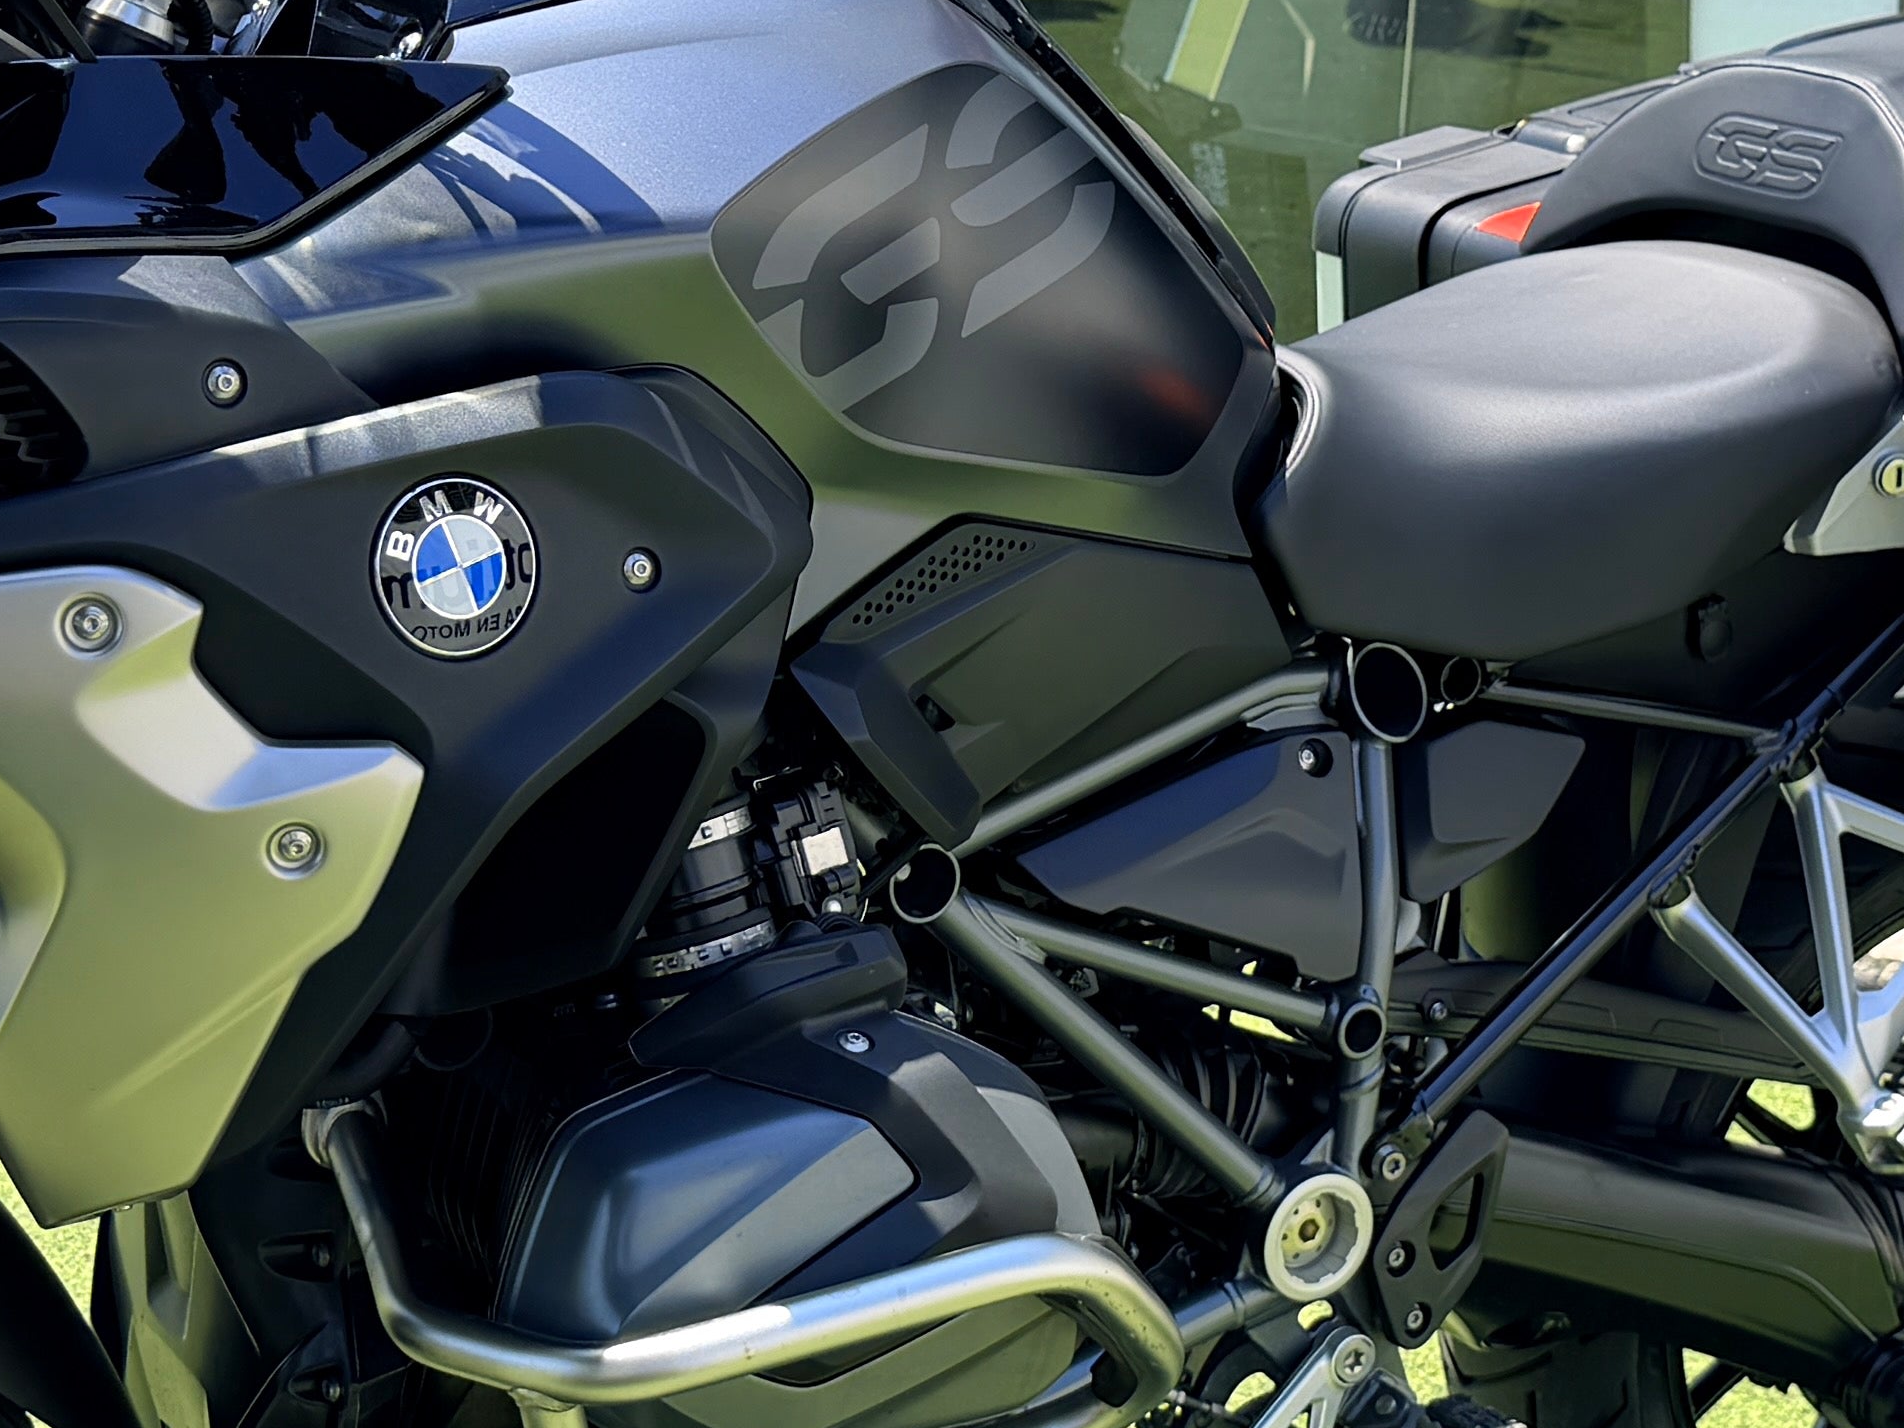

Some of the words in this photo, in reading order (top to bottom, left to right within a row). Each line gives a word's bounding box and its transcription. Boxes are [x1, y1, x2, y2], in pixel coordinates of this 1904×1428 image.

[1706, 115, 1842, 194] GS
[752, 72, 1116, 414] GS
[386, 489, 505, 562] BMW
